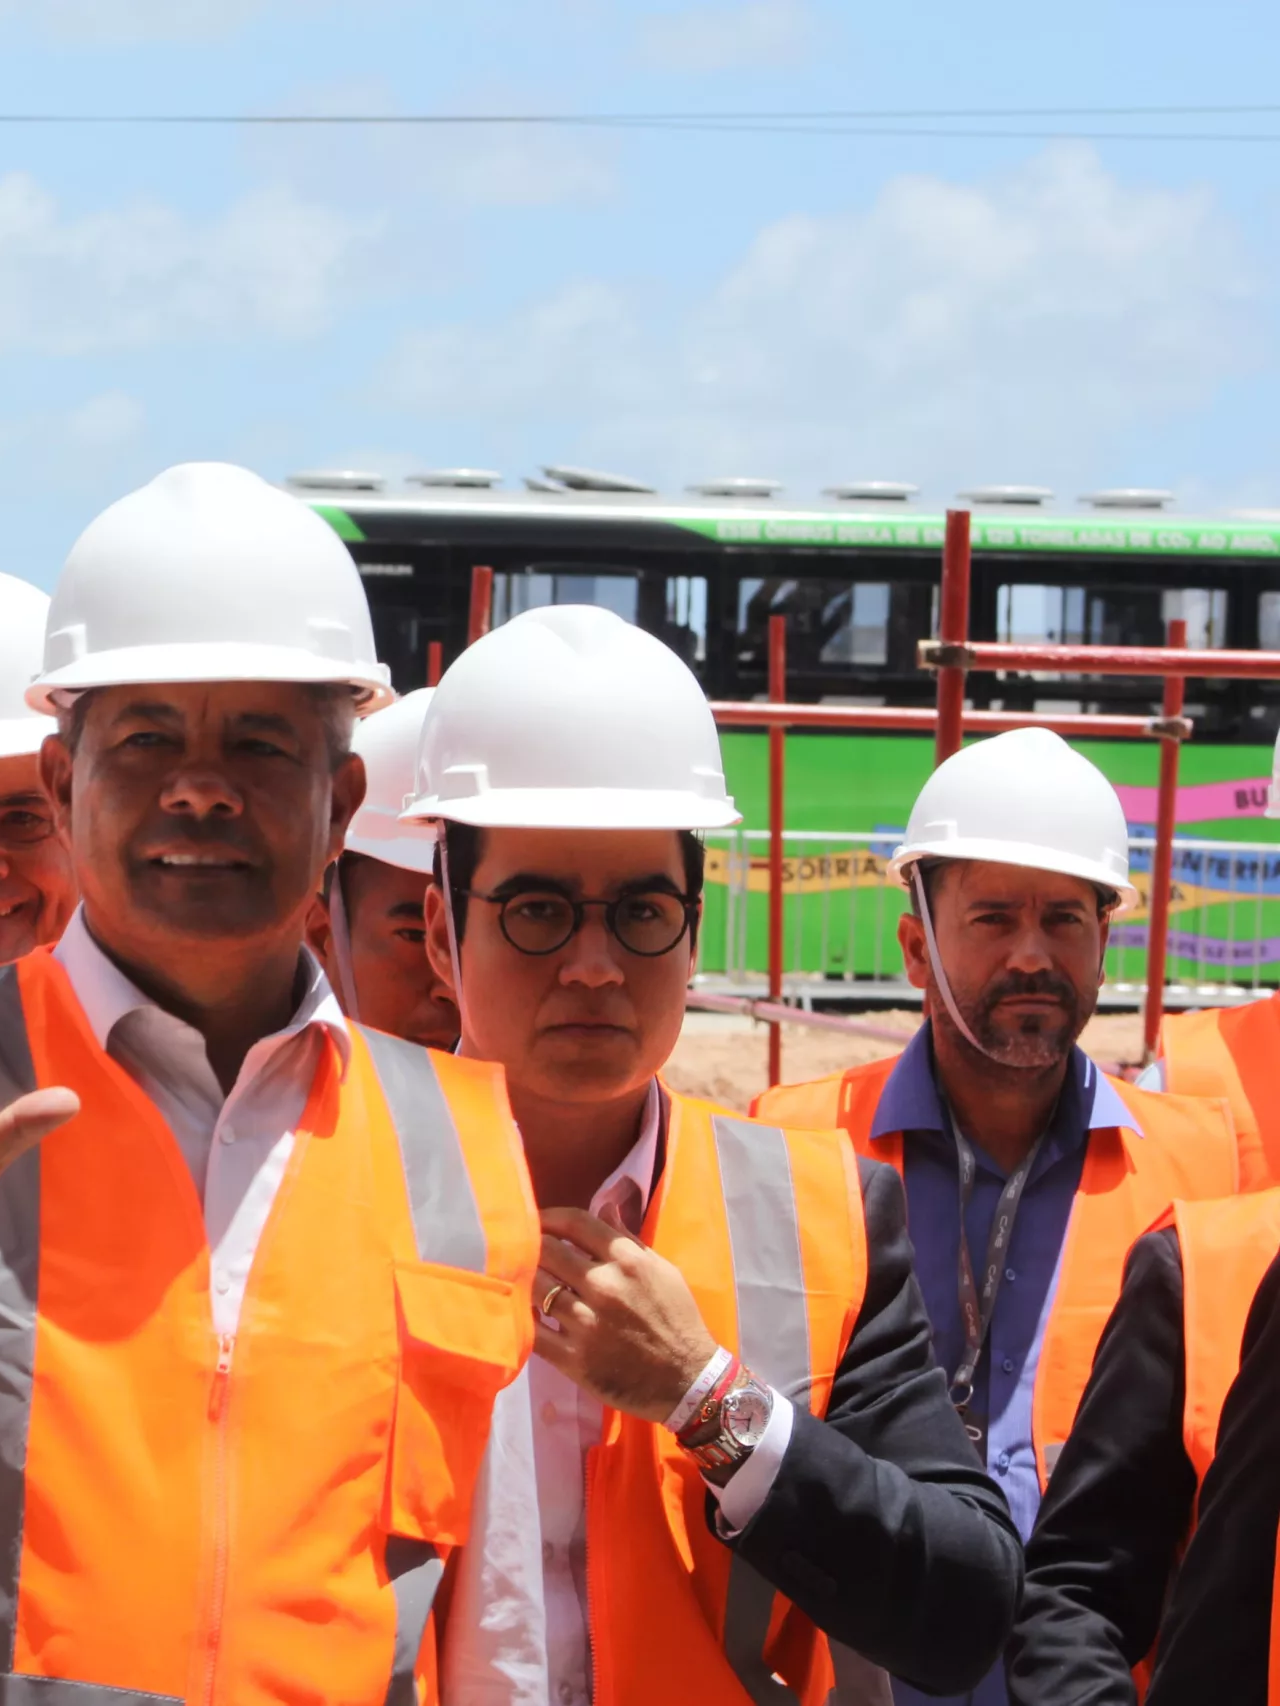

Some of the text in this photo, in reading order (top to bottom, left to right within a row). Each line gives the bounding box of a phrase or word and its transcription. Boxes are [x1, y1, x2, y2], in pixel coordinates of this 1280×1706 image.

[838, 525, 891, 543] DEIXA
[896, 525, 918, 544] DE
[1130, 530, 1153, 548] DE
